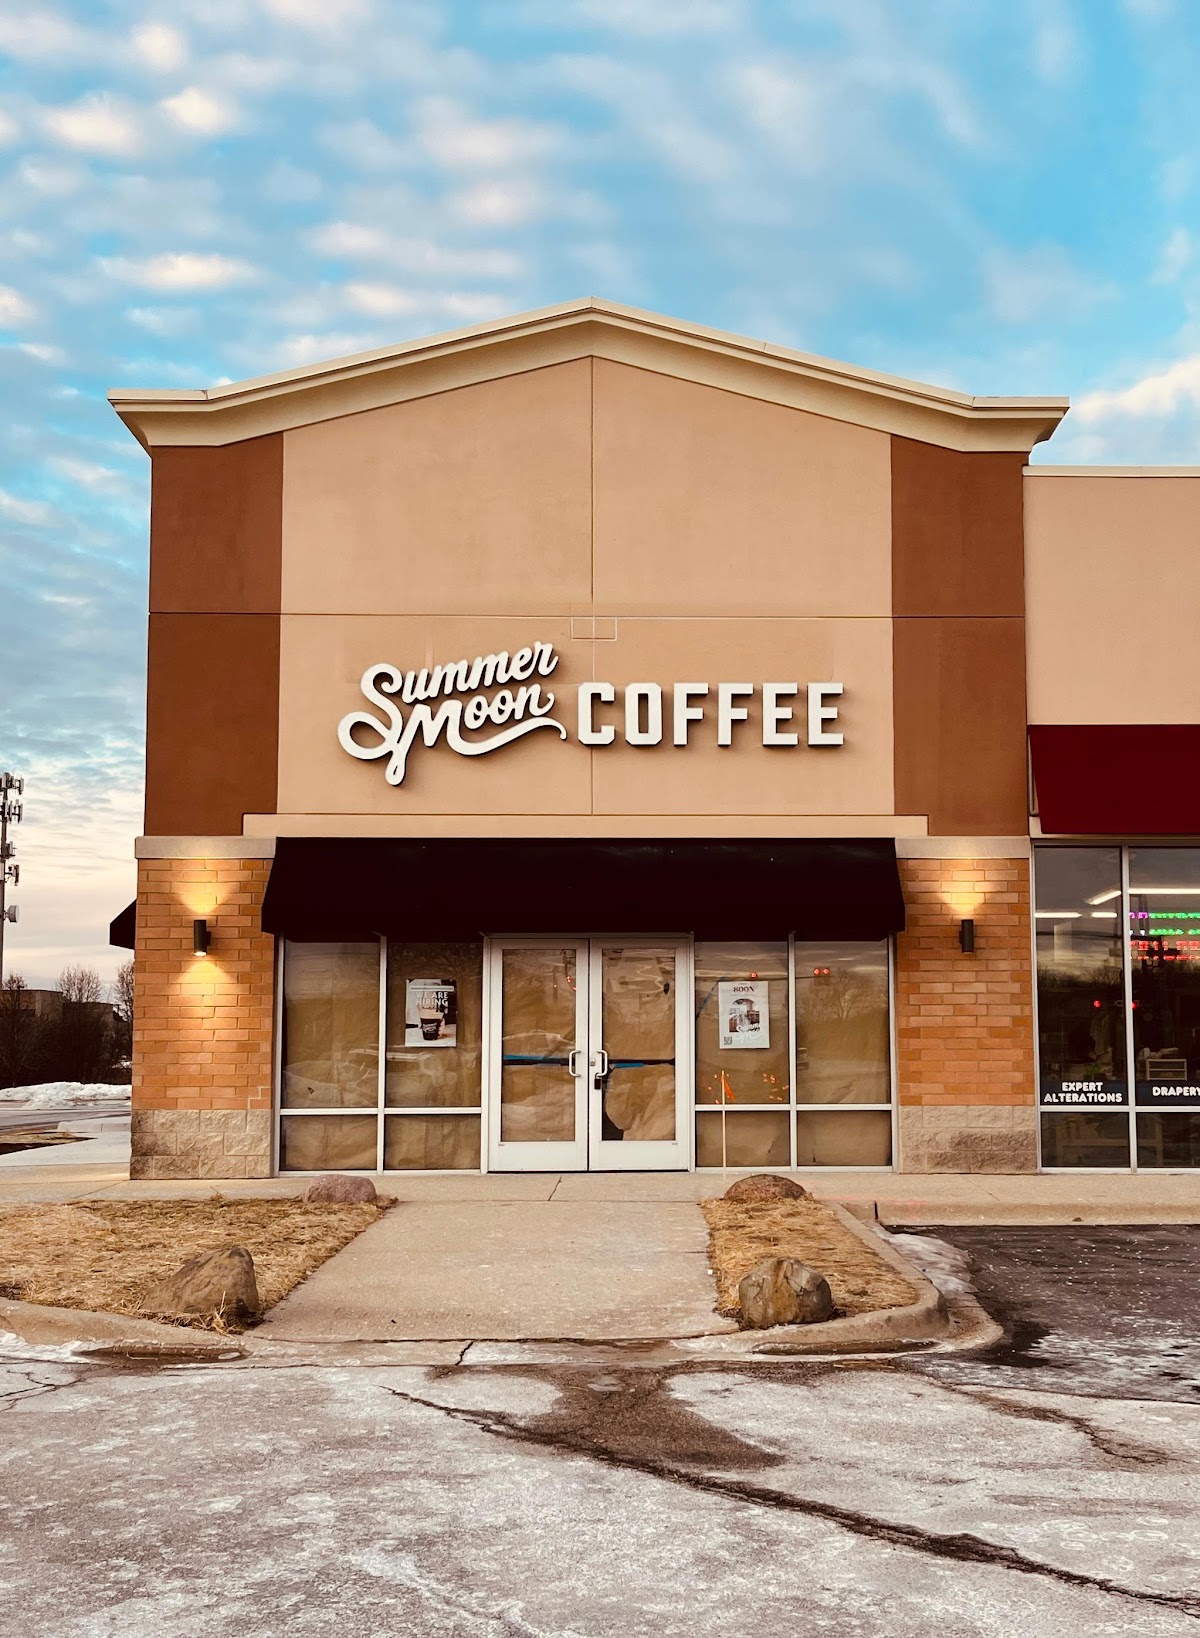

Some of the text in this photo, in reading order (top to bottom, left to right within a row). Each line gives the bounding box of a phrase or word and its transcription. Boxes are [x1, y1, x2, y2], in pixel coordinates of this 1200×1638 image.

[337, 641, 559, 760] Summer
[577, 682, 844, 747] COFFEE
[385, 684, 567, 786] Moon
[416, 998, 449, 1006] HIRING
[1043, 1093, 1123, 1103] ALTERATIONS
[1061, 1082, 1104, 1092] EXPERT
